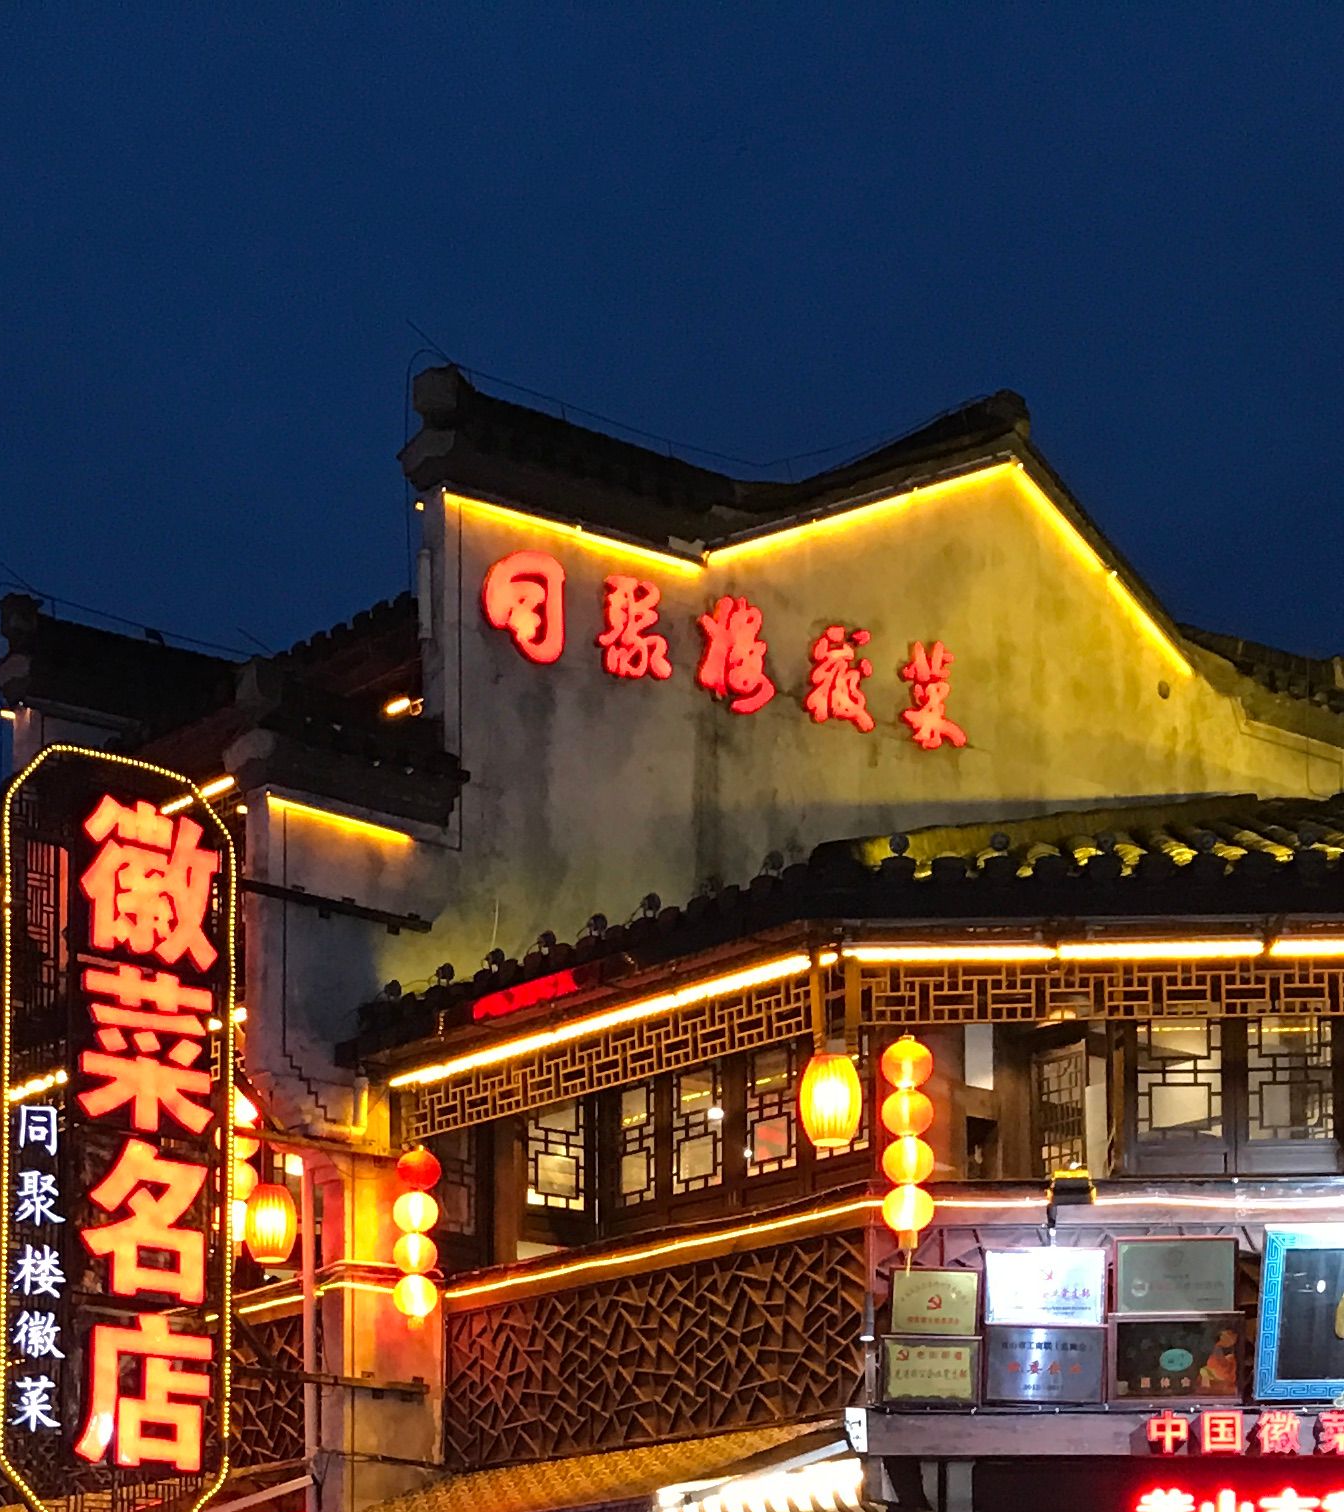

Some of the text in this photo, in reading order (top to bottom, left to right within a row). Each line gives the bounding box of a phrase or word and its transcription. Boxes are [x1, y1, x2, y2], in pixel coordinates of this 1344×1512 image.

[12, 1104, 67, 1434] 同聚楼徽菜
[77, 794, 221, 1474] 徽菜名店
